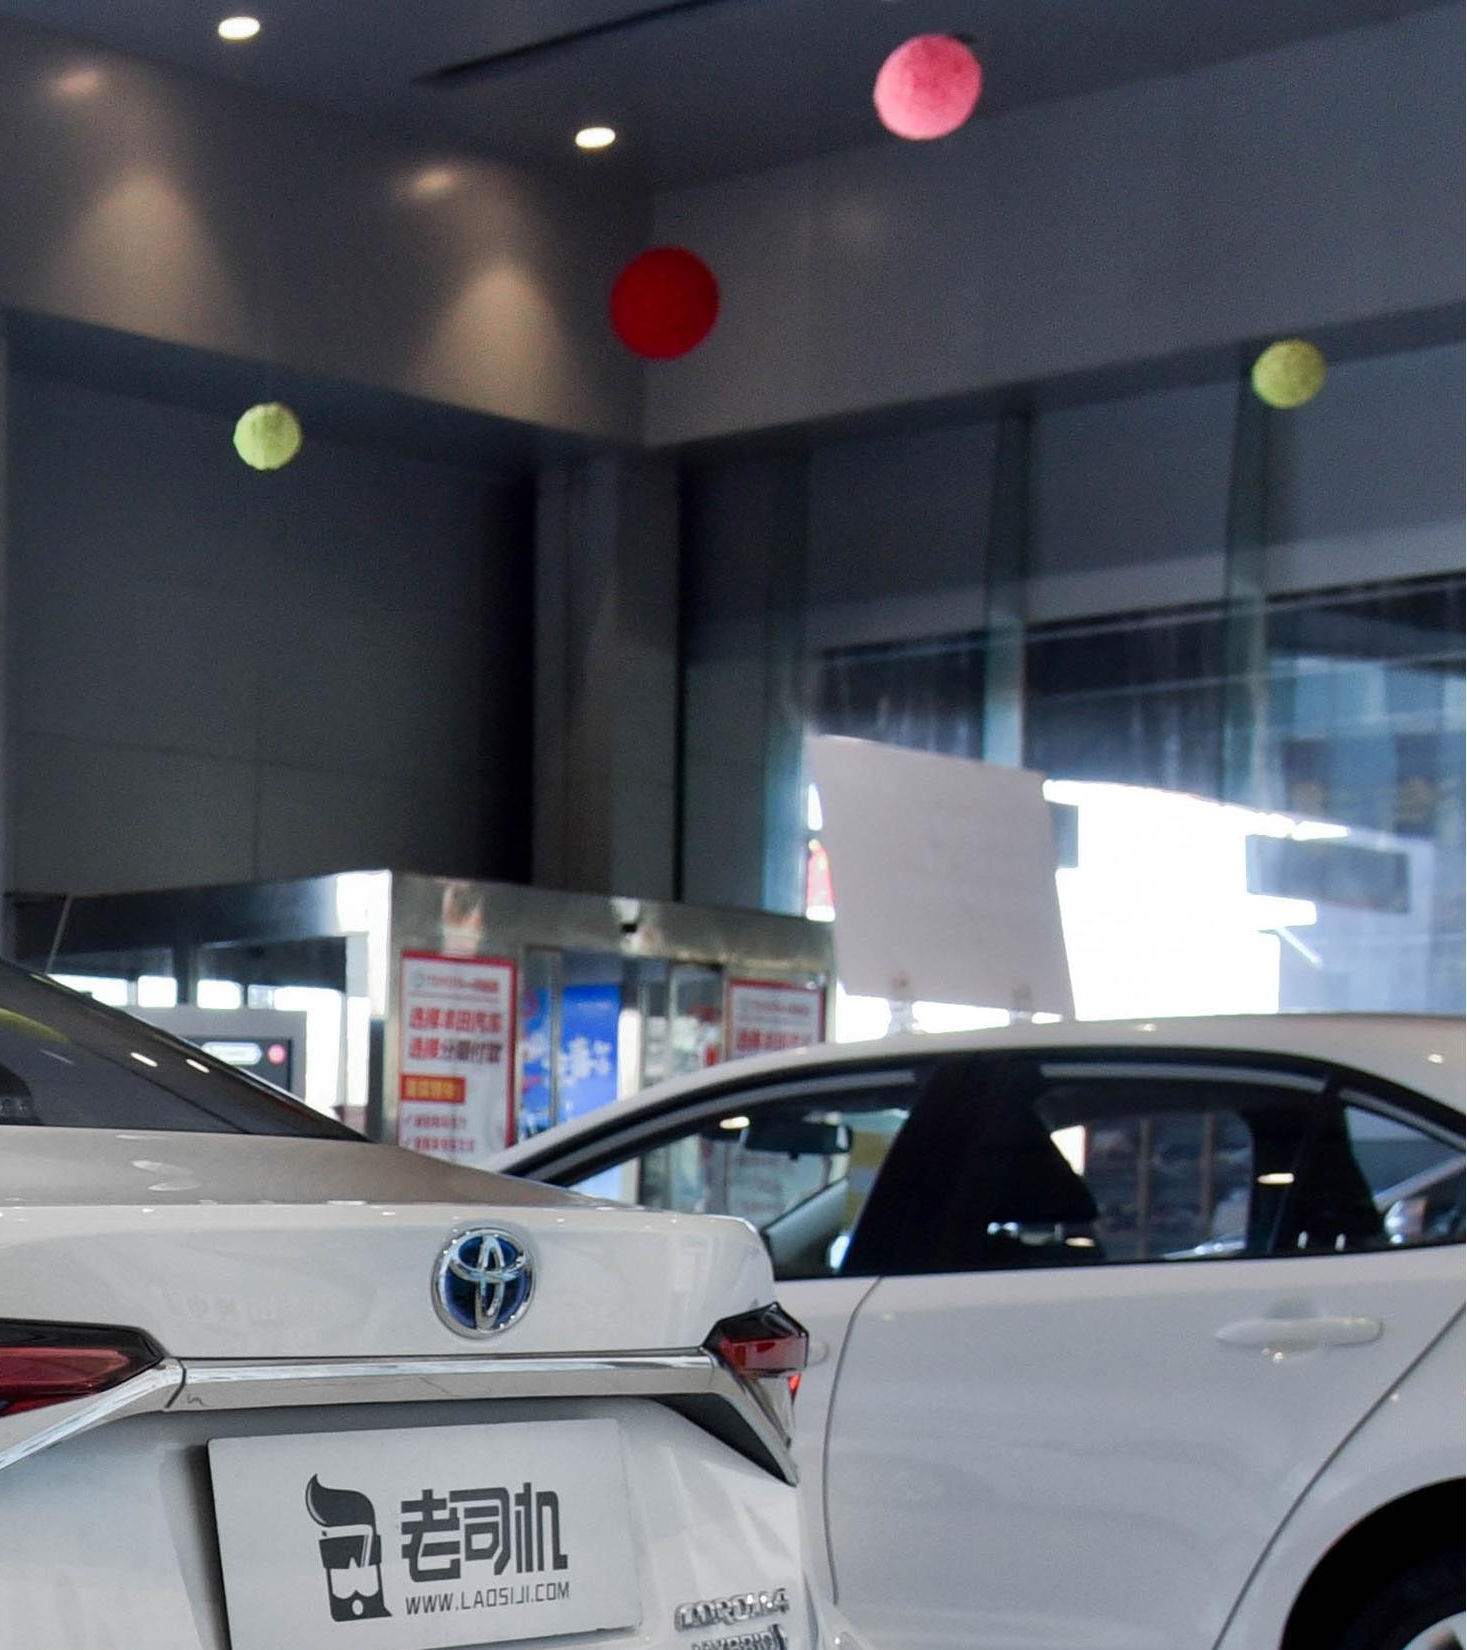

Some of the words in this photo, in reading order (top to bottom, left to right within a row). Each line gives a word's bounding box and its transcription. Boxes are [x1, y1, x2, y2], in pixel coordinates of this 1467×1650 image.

[400, 1482, 569, 1583] 老司机
[405, 1581, 570, 1616] WWW.LAOSIJI.COM
